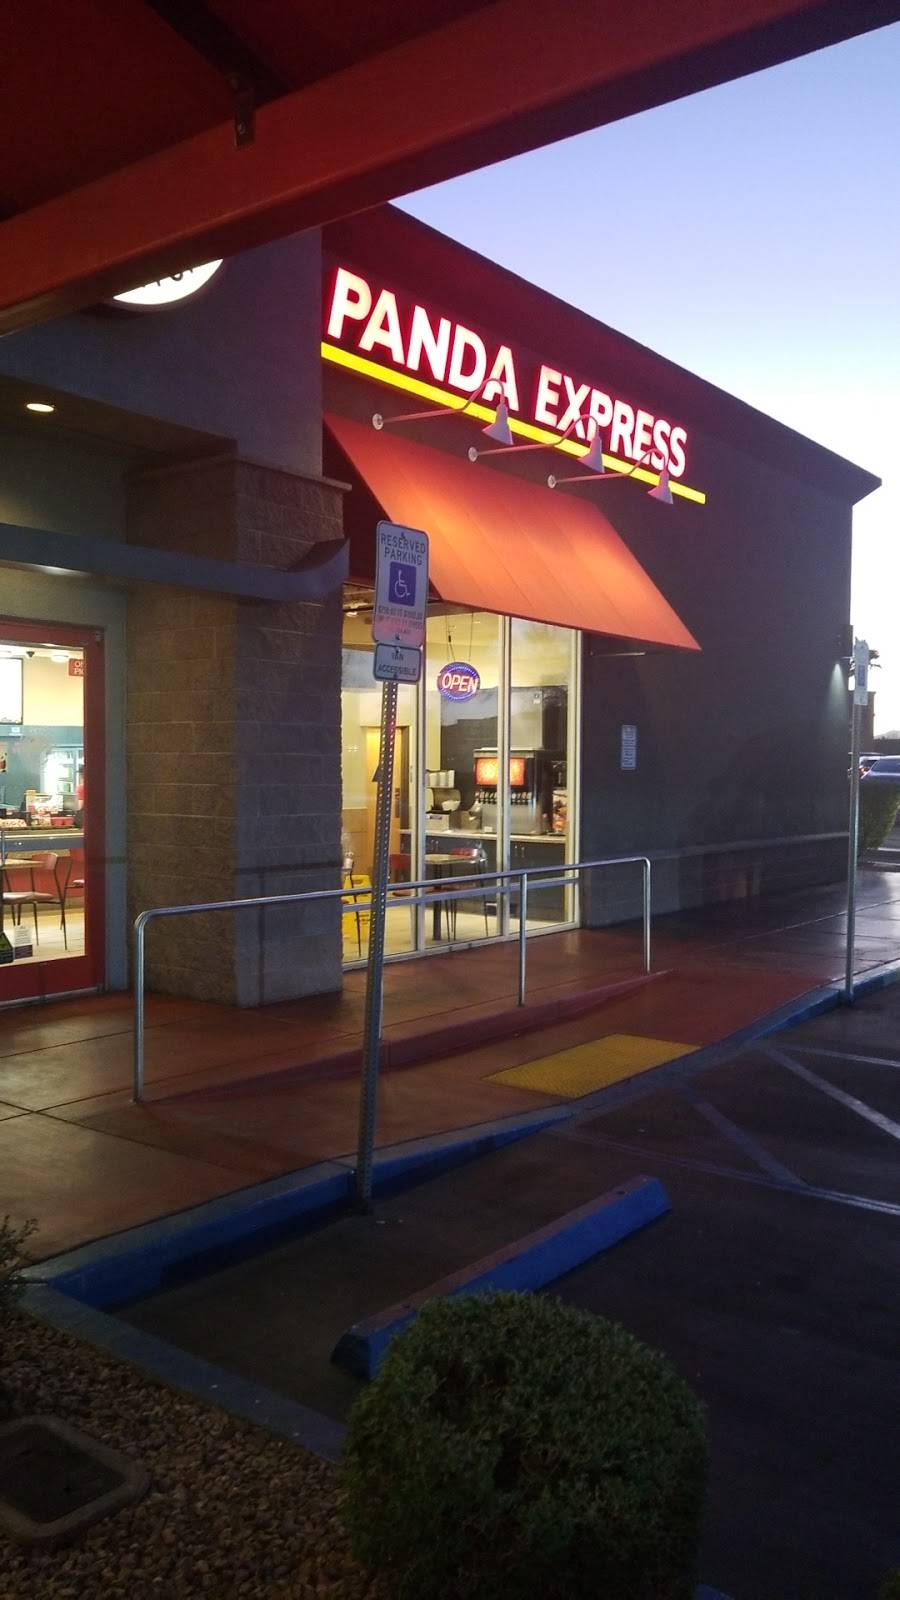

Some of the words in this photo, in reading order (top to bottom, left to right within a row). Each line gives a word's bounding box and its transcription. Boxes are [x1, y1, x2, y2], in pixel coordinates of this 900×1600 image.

[328, 267, 519, 411] PANDA
[535, 365, 687, 478] EXPRESS
[380, 533, 426, 554] RESERVED
[384, 546, 422, 566] PARKING
[441, 672, 479, 694] OPEN
